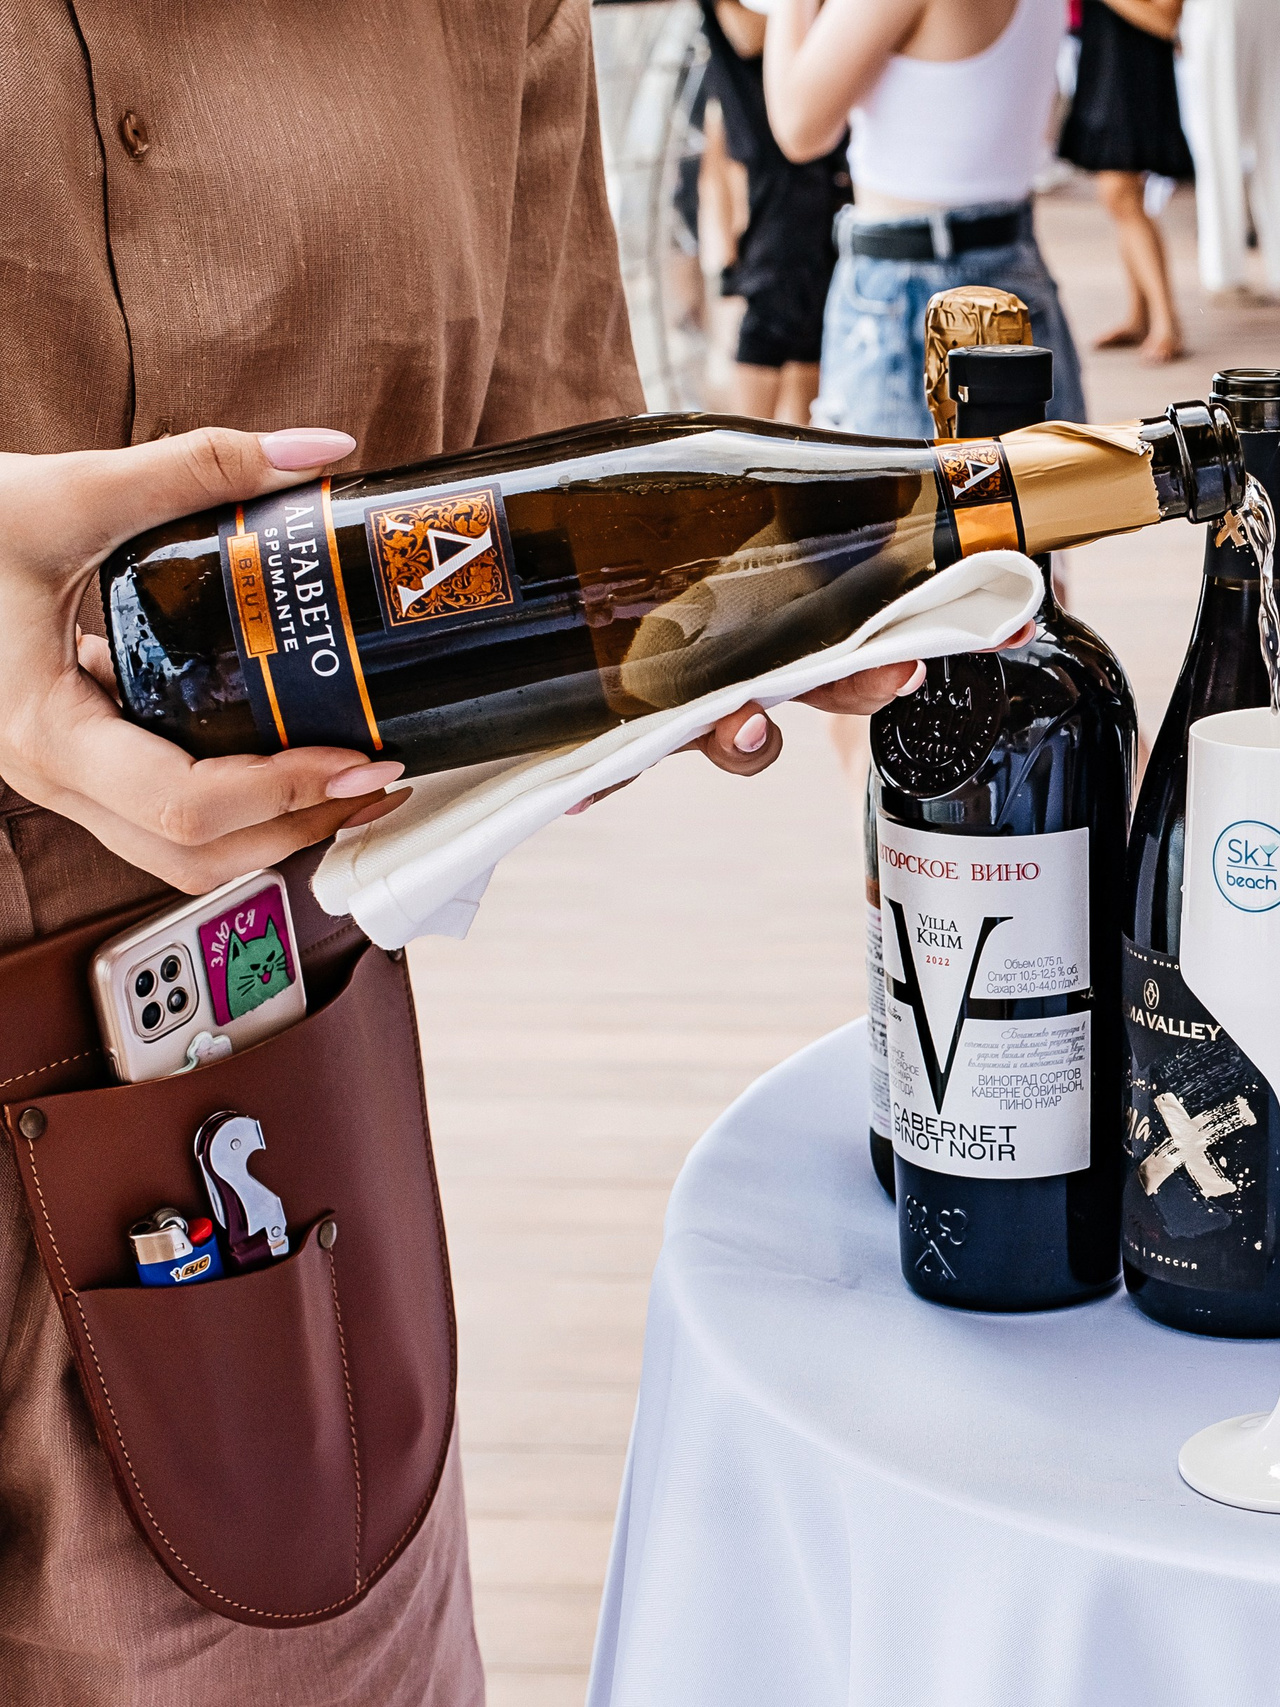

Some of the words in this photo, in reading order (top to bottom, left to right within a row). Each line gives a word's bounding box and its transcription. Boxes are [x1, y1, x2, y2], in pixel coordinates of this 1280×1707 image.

[238, 557, 263, 625] BRUT
[264, 528, 300, 652] SPUMANTE
[285, 505, 340, 678] ALFABETO
[971, 862, 1041, 882] ВИНО
[1226, 870, 1277, 891] beach
[926, 954, 950, 967] 2022
[1036, 957, 1055, 968] 0,75
[987, 971, 1017, 985] Спирт
[987, 981, 1016, 995] Сахар
[1146, 1012, 1222, 1042] VALLEY
[978, 1074, 1037, 1087] ВИНОГРАД
[1039, 1068, 1082, 1084] СОРТОВ
[971, 1085, 1021, 1098] КАБЕРНЕ
[999, 1098, 1032, 1110] ПИНО
[1035, 1096, 1062, 1109] НУАР
[893, 1102, 1017, 1143] CABERNET
[895, 1121, 944, 1154] PINOT
[949, 1142, 1016, 1161] NOIR
[184, 1256, 208, 1277] BIC
[1150, 1251, 1198, 1270] РОССИЯ
